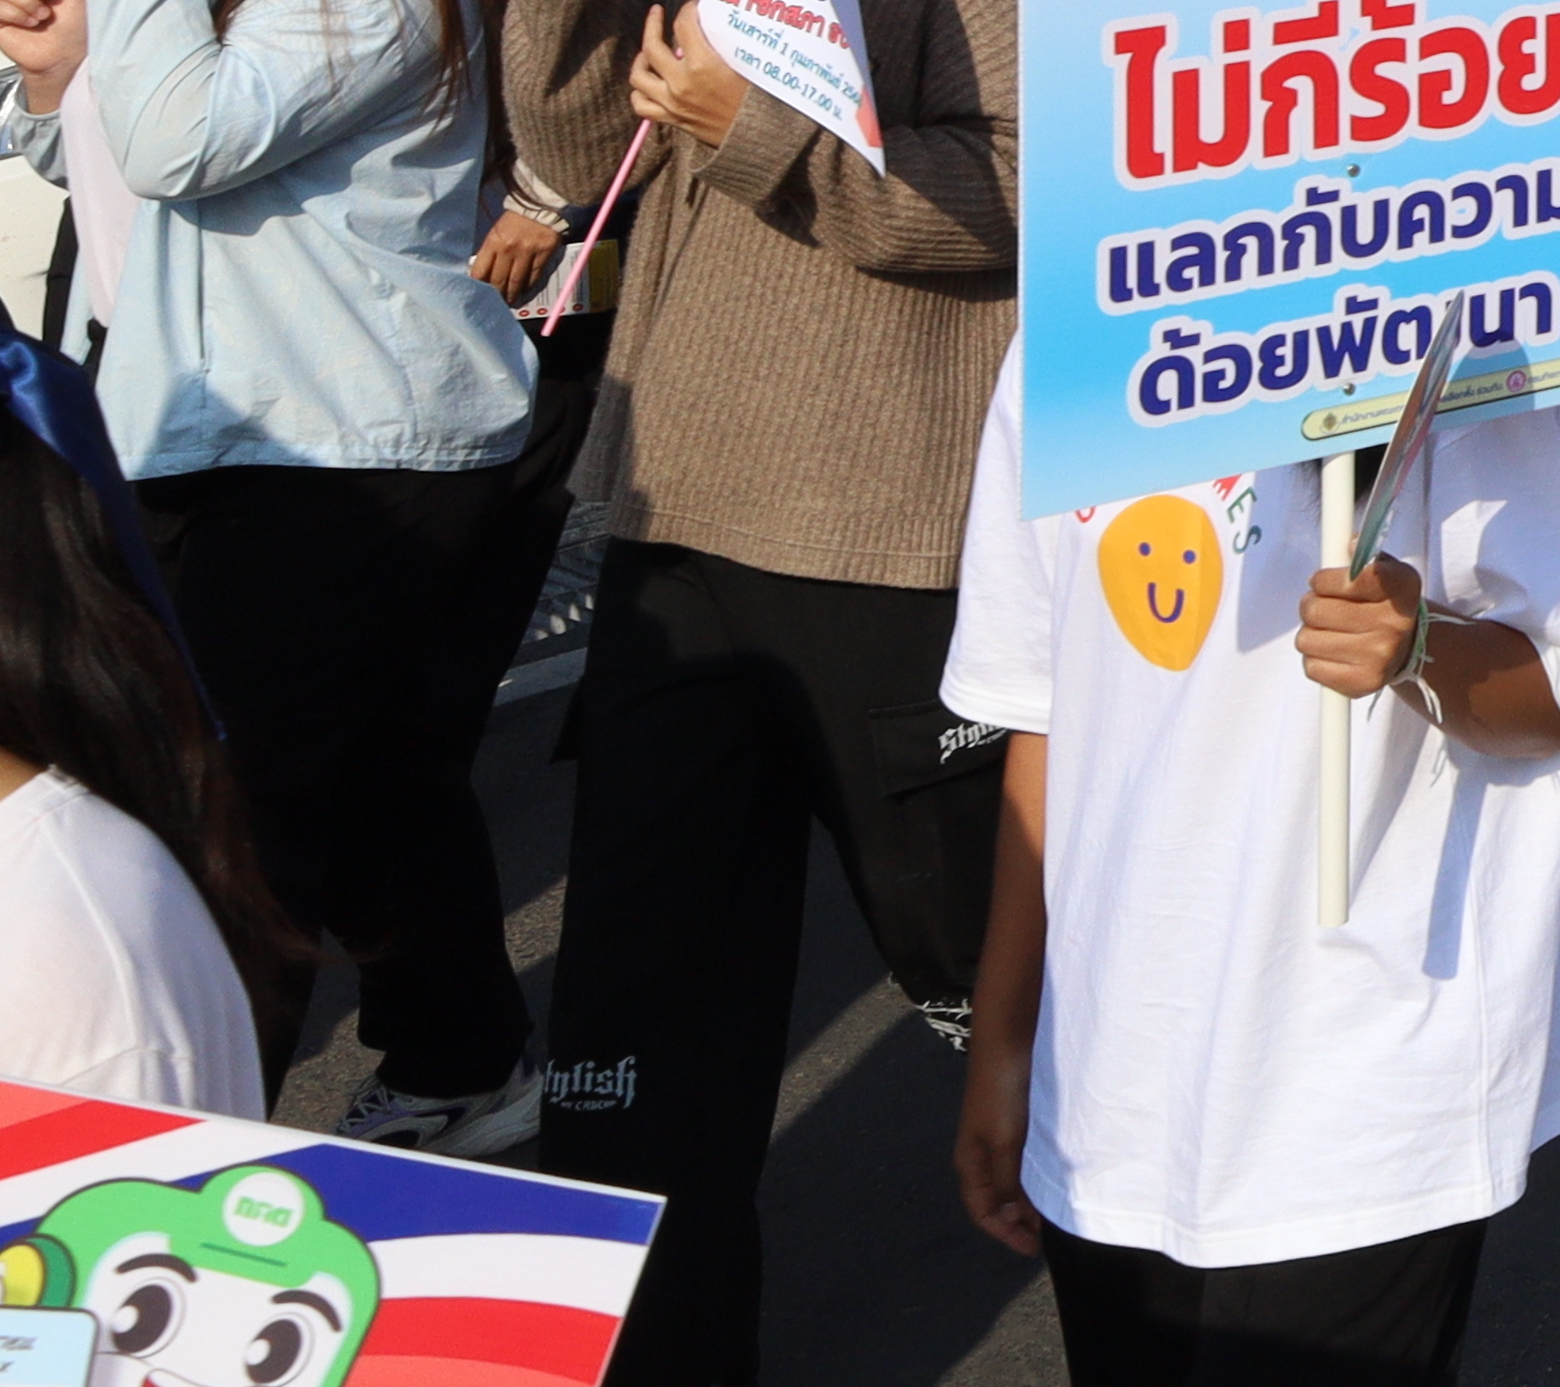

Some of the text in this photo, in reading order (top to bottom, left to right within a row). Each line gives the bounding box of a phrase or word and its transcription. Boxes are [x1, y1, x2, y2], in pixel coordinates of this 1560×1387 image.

[727, 11, 783, 51] วันเสาร์ที่
[733, 45, 761, 70] เวลา
[544, 1054, 638, 1109] tylish
[234, 1194, 294, 1230] กกต
